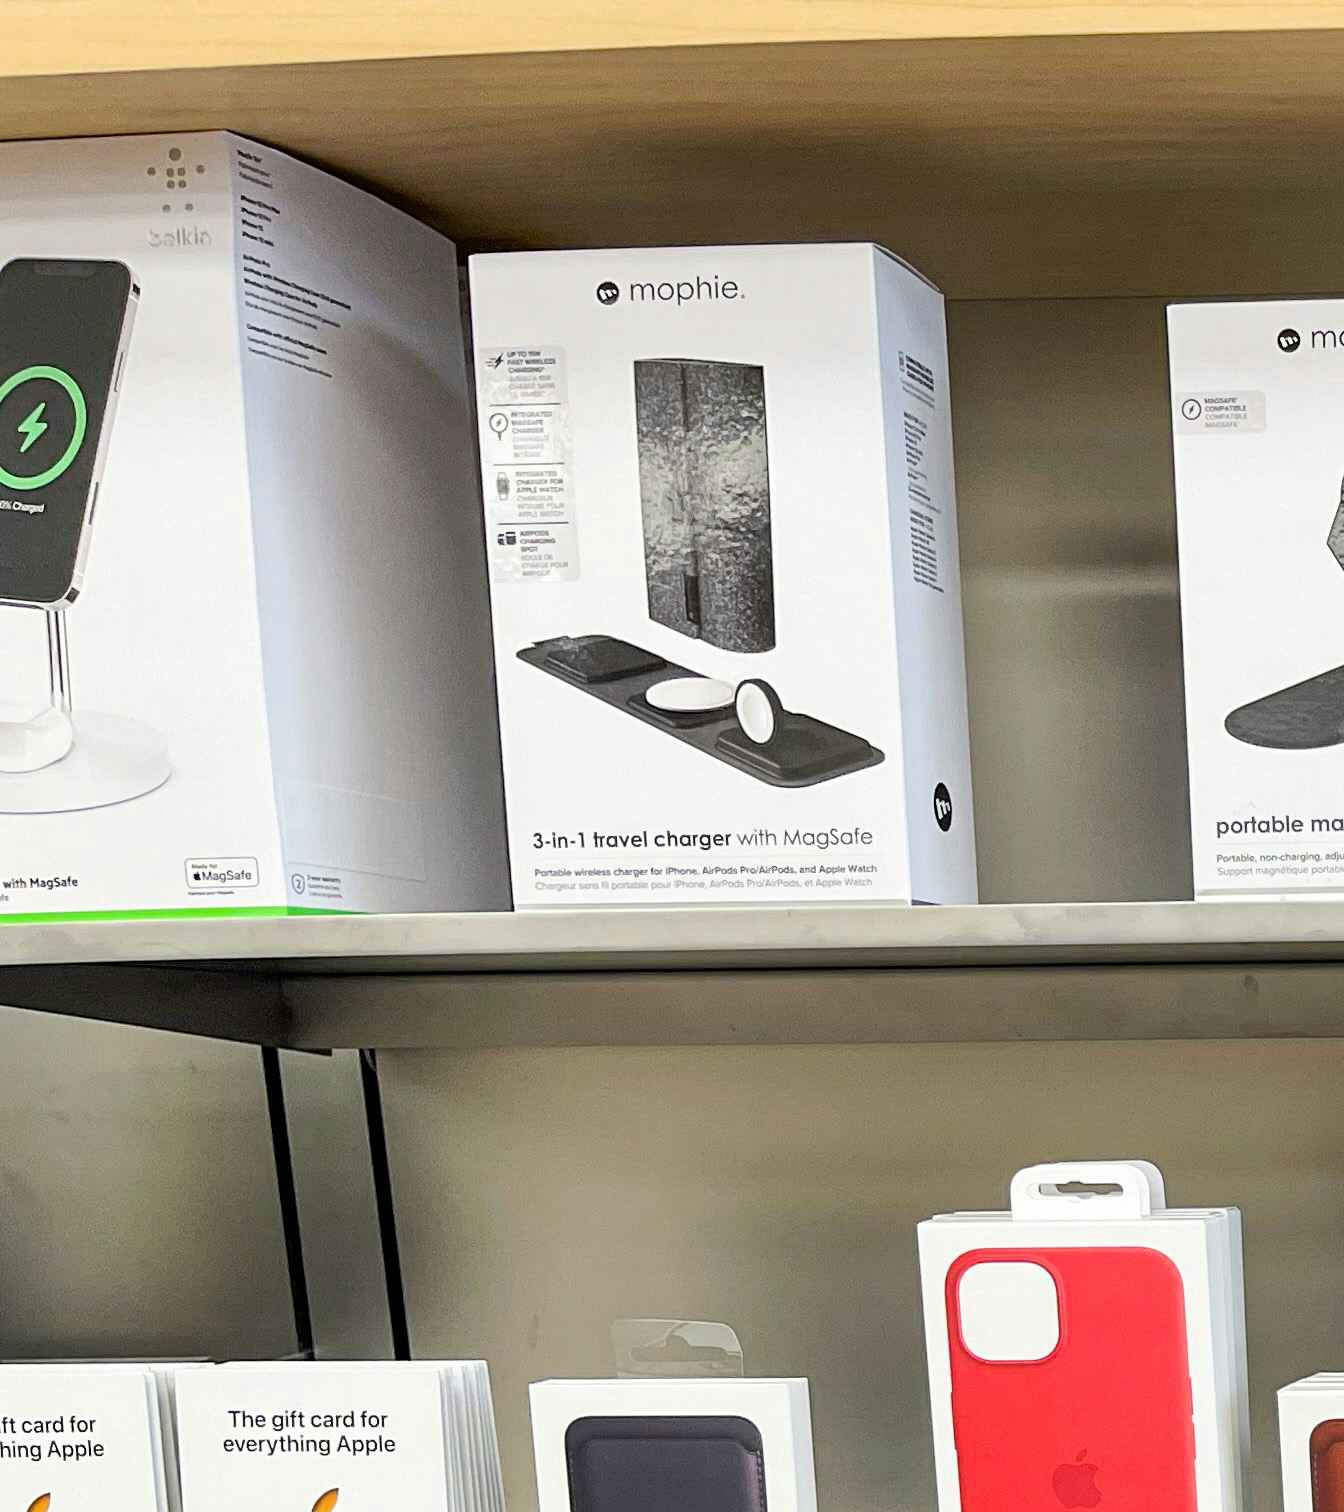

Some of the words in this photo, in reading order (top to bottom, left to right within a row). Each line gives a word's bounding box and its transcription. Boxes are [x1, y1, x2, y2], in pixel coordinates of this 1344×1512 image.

[1217, 815, 1303, 838] portable
[533, 833, 585, 849] 3-in-1
[595, 831, 647, 848] travel
[655, 831, 731, 853] charger
[737, 830, 777, 846] with
[784, 829, 872, 849] MagSafe
[202, 870, 251, 882] MagSafe
[614, 868, 648, 878] charger
[651, 867, 662, 875] for
[800, 865, 816, 873] and
[820, 865, 846, 875] Apple
[849, 864, 877, 873] Watch
[3, 879, 27, 890] with
[30, 877, 78, 891] MagSafe
[22, 1417, 64, 1434] card
[70, 1417, 96, 1432] for
[229, 1411, 265, 1428] The
[272, 1411, 305, 1432] gift
[312, 1411, 354, 1428] card
[361, 1411, 387, 1427] for
[48, 1442, 104, 1461] Apple
[223, 1436, 330, 1455] everything
[337, 1436, 396, 1455] Apple
